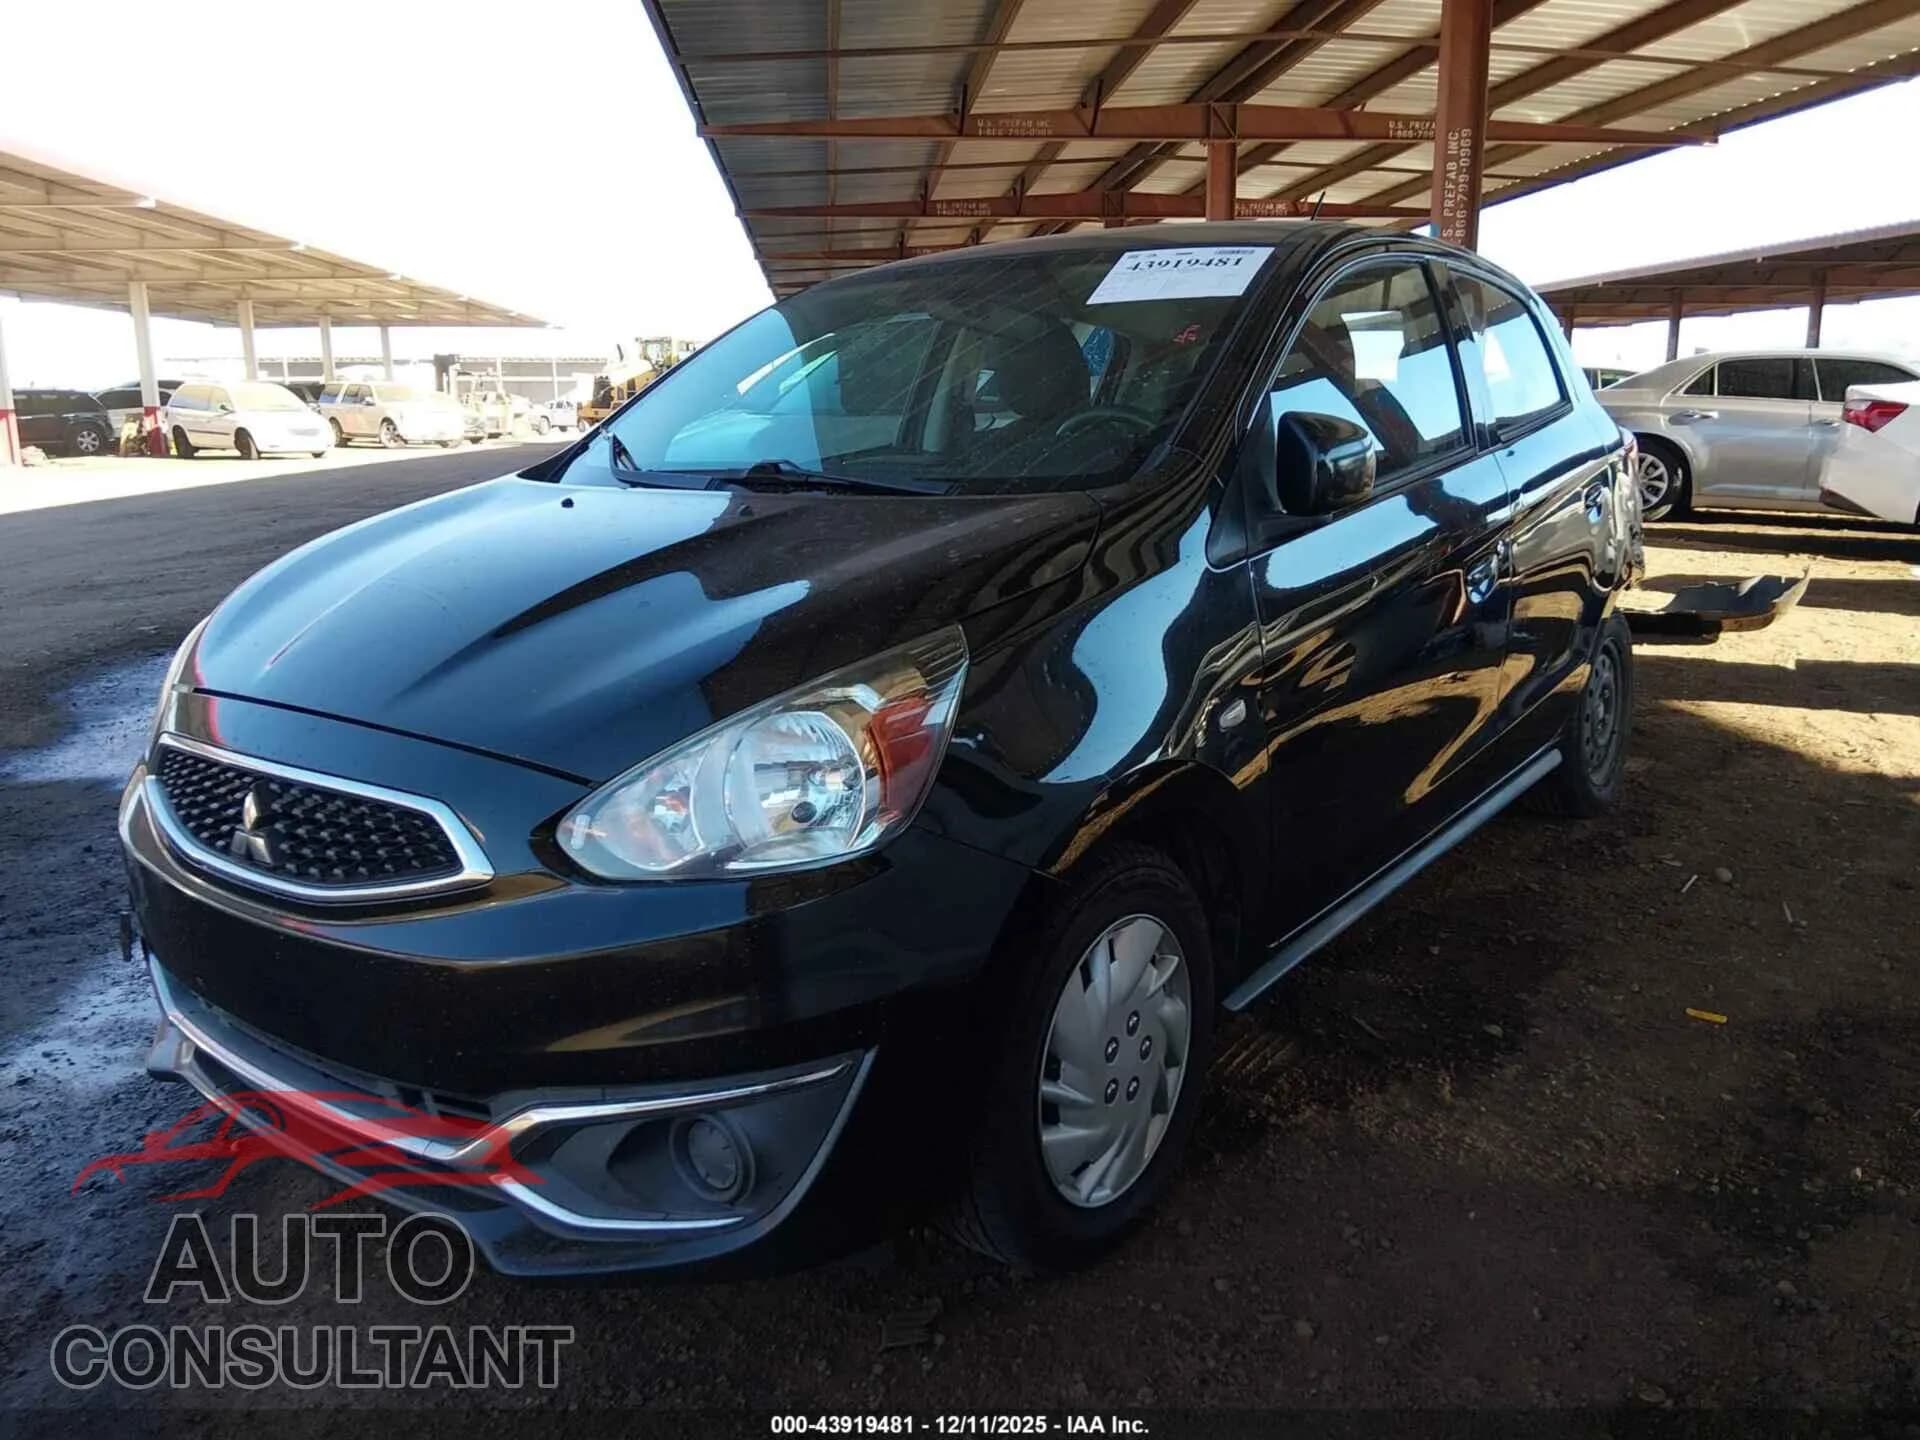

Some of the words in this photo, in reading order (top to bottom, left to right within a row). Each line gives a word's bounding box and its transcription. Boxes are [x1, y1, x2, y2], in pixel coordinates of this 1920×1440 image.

[1447, 127, 1460, 155] INC.
[1443, 161, 1458, 218] PREFAB
[1455, 128, 1472, 248] -866-799-0969
[1127, 257, 1242, 270] 43919481
